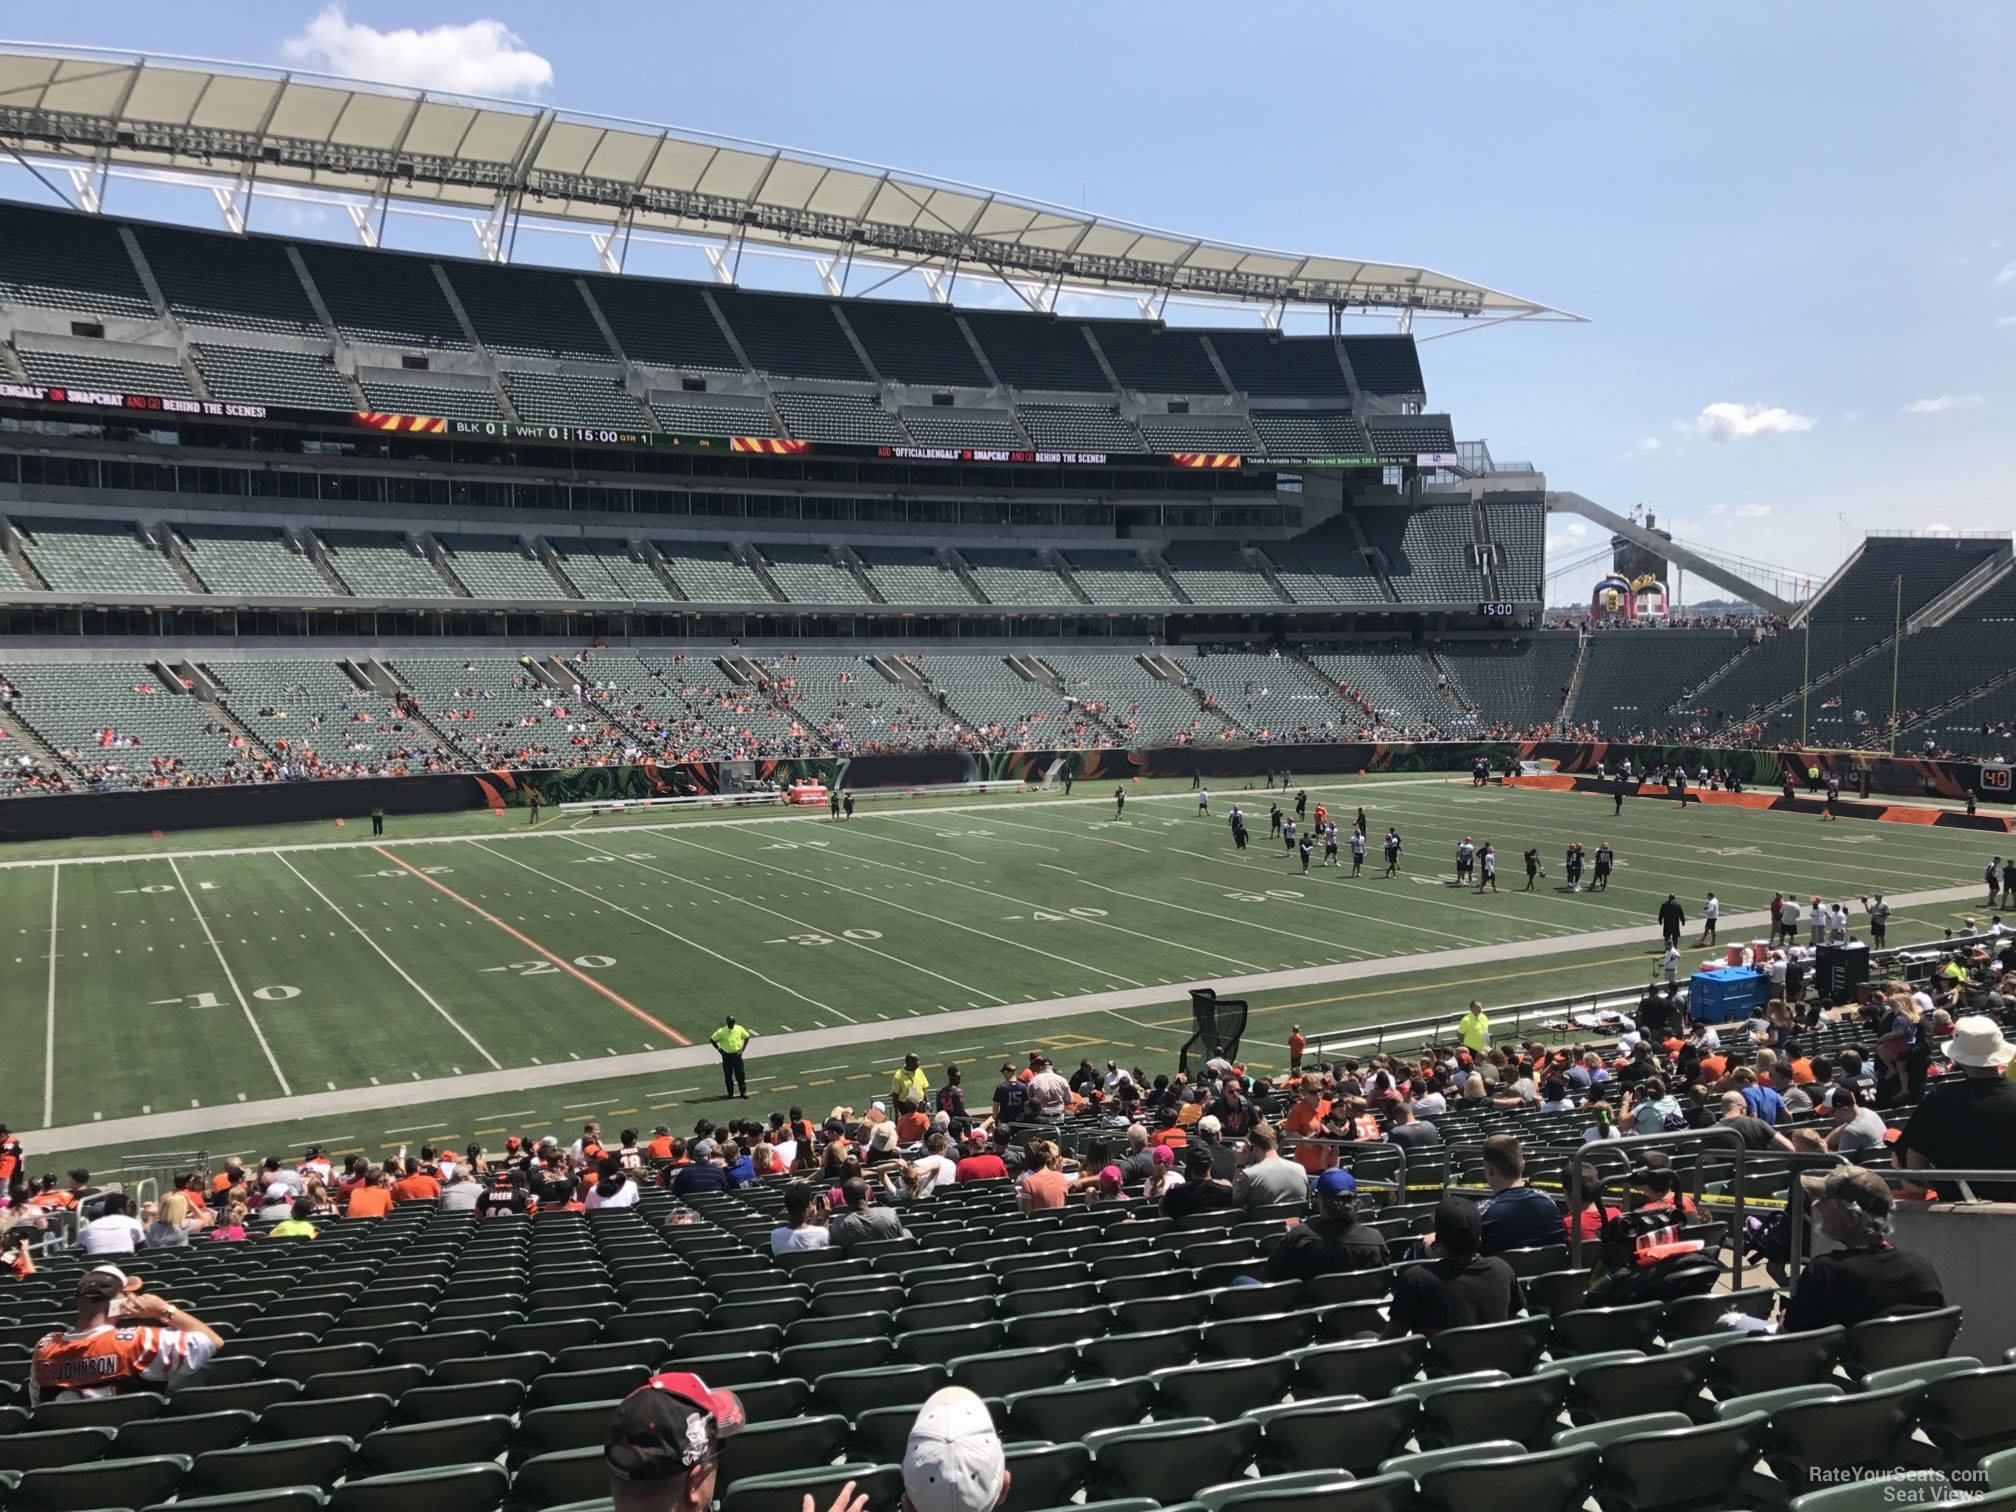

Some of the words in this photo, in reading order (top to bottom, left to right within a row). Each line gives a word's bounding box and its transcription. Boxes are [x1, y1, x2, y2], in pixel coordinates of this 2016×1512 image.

[162, 399, 200, 413] BEHIND
[203, 403, 223, 415] THE
[225, 404, 266, 418] SCENES!
[456, 422, 480, 433] BLK
[485, 423, 496, 434] 0
[516, 426, 544, 437] WHT
[548, 427, 558, 439] 0
[576, 429, 618, 443] 15:00
[620, 434, 637, 442] QTR
[641, 434, 647, 443] 1
[973, 451, 1010, 461] SNAPCHAT
[1035, 452, 1061, 463] BEHIND
[1062, 453, 1077, 463] THE
[1078, 454, 1107, 464] SCENES!
[1483, 604, 1512, 615] 15:00
[1985, 771, 2007, 787] 40
[1223, 889, 1304, 902] 50
[1032, 906, 1108, 922] 40
[786, 928, 883, 946] 30
[508, 955, 617, 976] 20
[187, 985, 302, 1009] 10
[1008, 1091, 1022, 1106] 15
[489, 1191, 512, 1200] GREEN
[59, 1354, 118, 1379] JOHNSON
